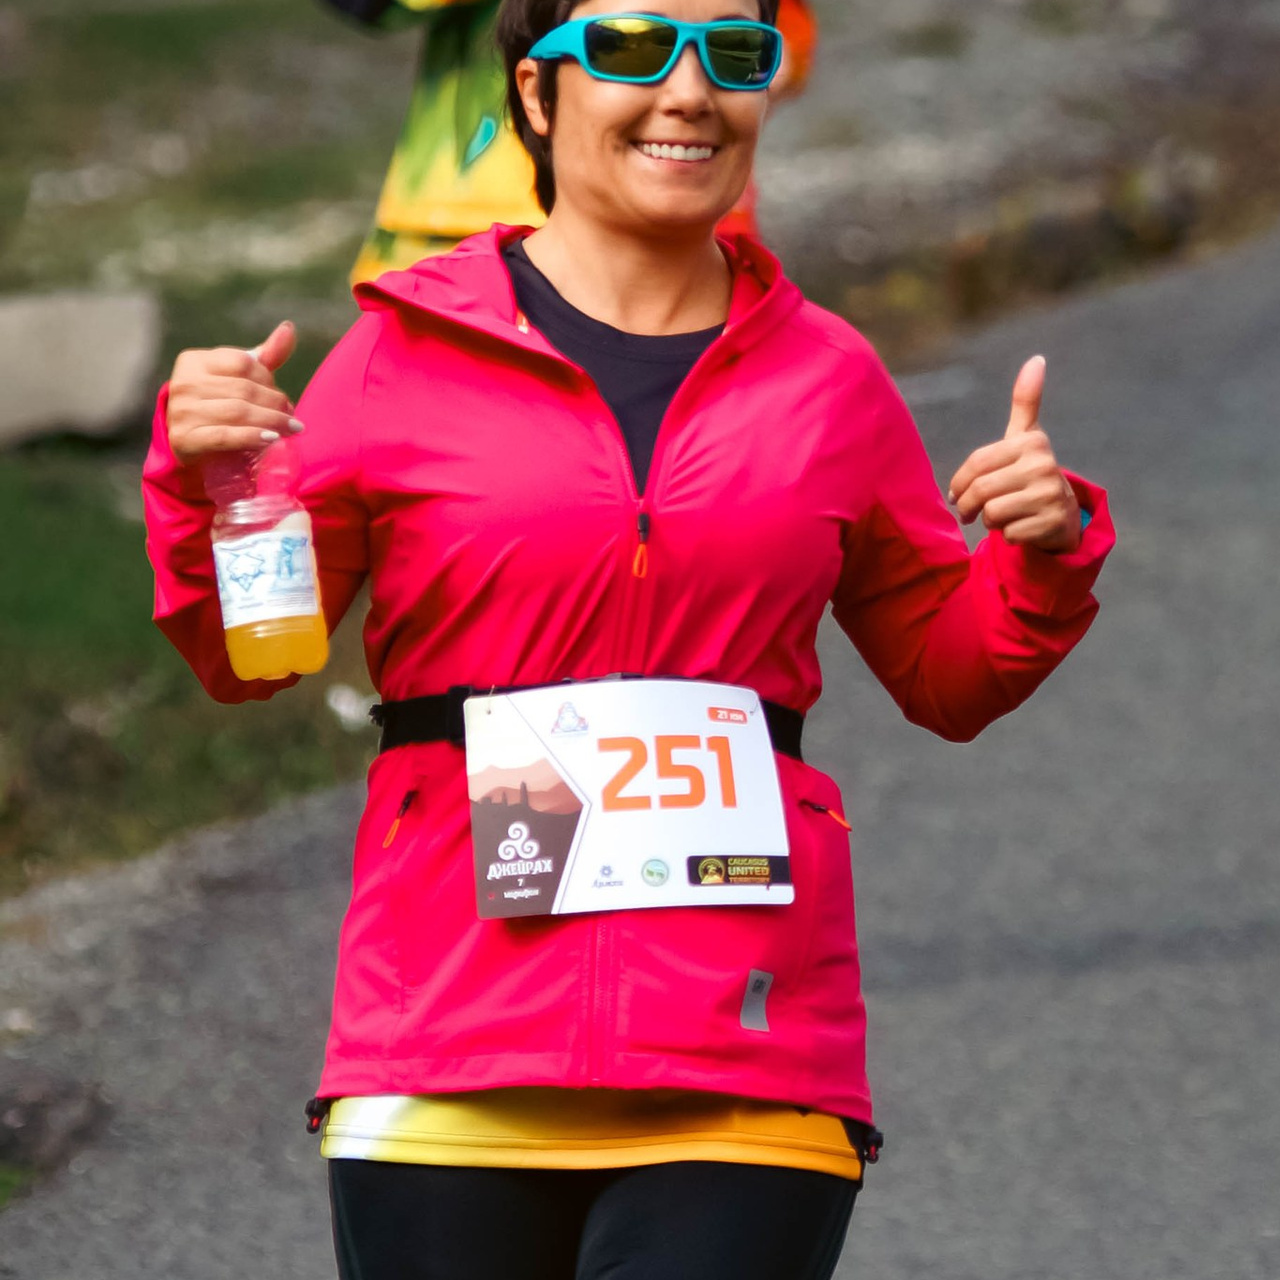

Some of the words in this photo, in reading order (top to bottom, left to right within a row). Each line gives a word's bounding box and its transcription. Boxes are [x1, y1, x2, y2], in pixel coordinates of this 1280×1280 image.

[597, 734, 737, 812] 251
[487, 859, 554, 880] ДЖЕЙРАХ
[727, 866, 771, 876] UNITED
